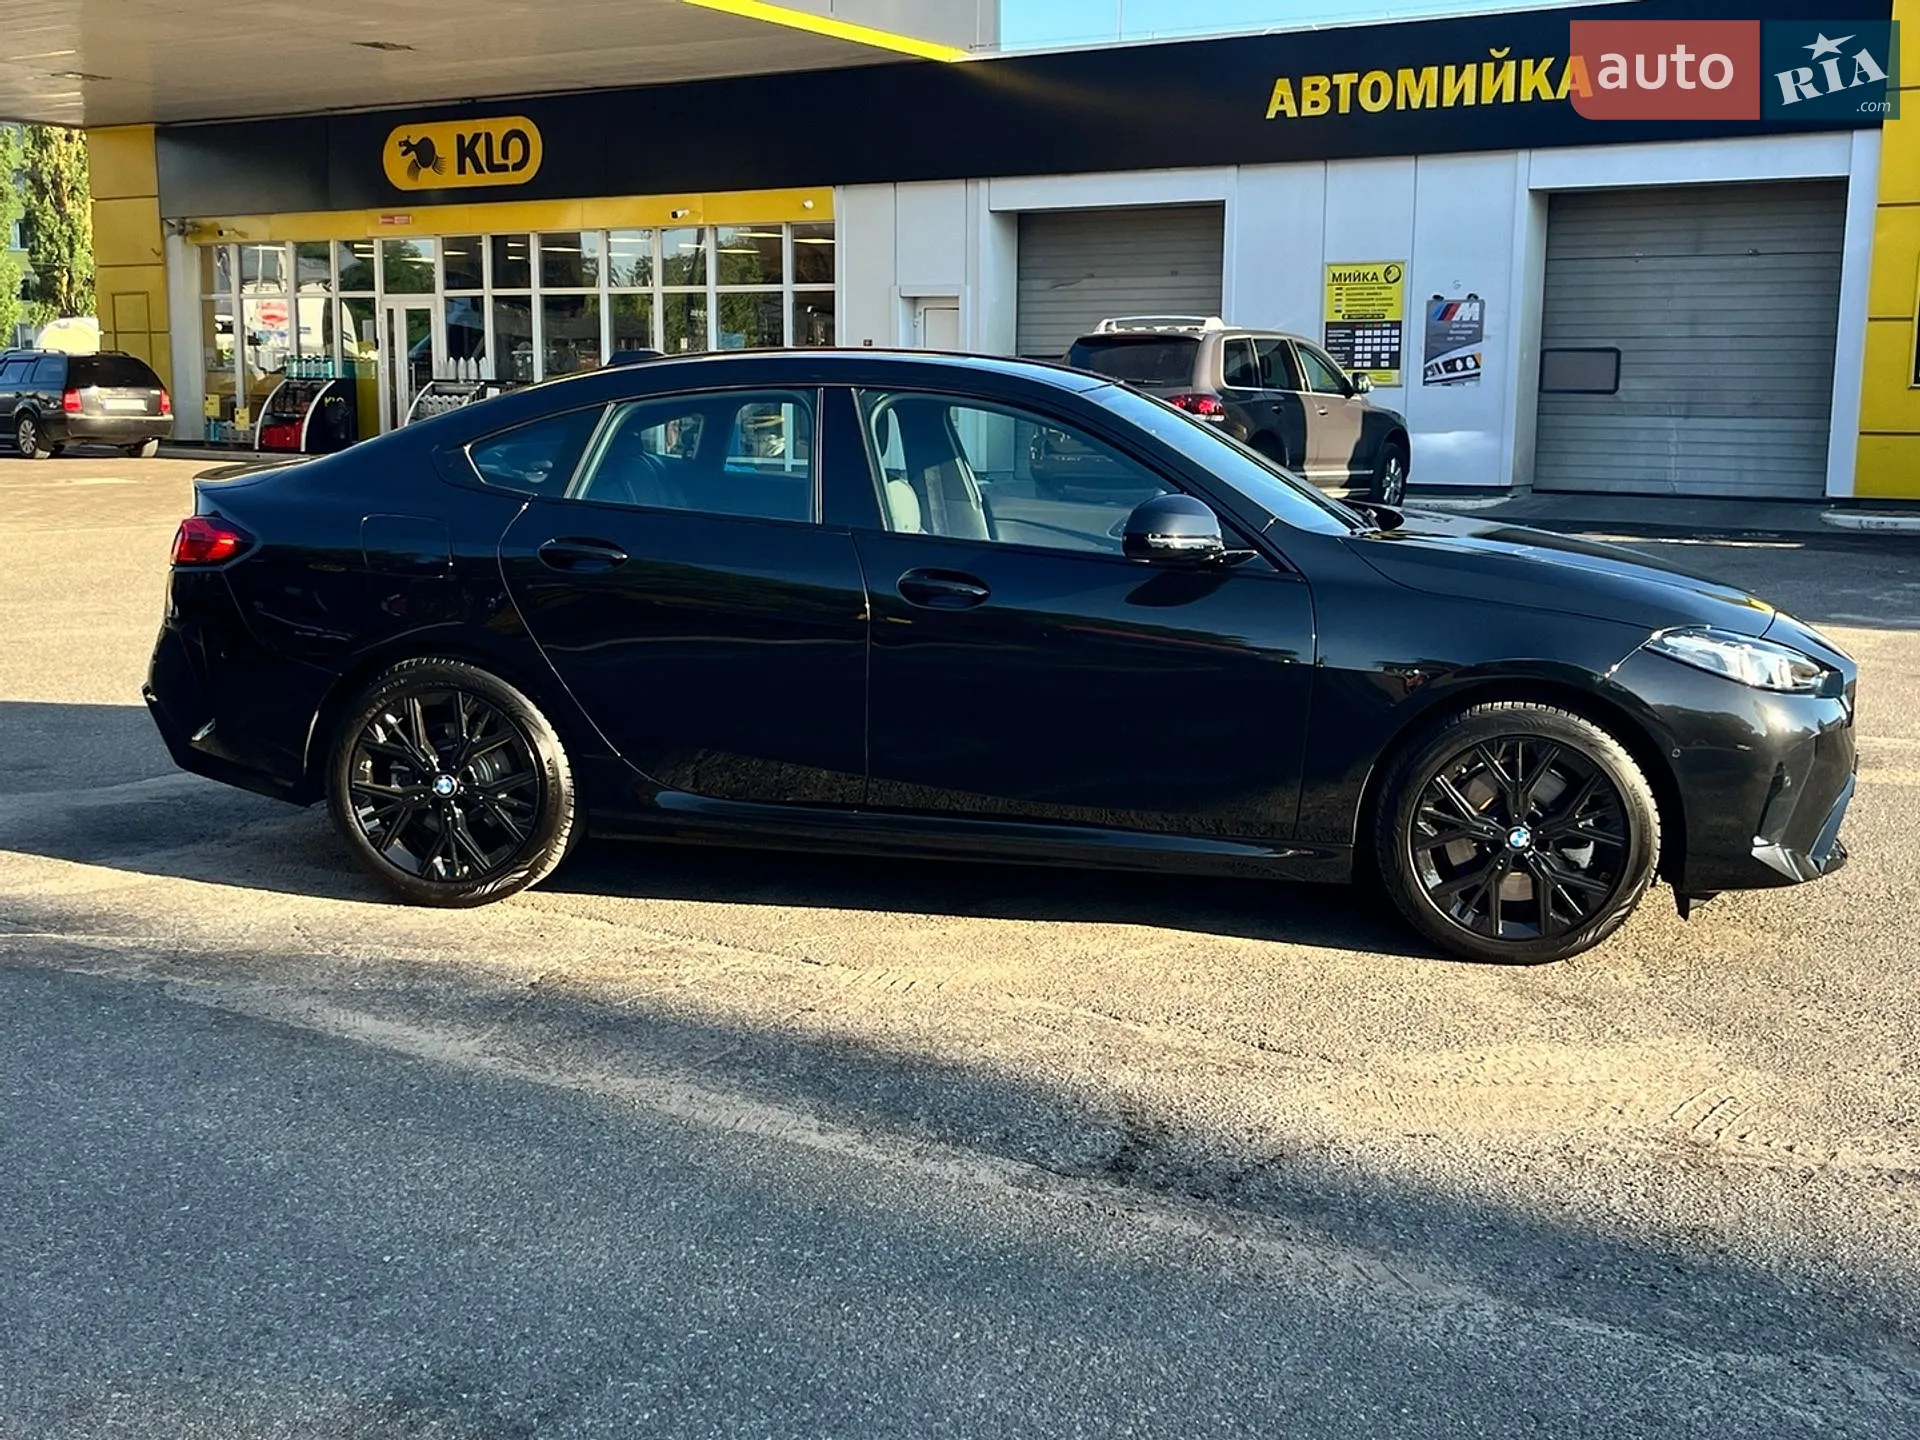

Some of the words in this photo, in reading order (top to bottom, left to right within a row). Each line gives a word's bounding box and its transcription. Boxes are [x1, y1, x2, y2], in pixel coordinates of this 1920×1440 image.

[1265, 47, 1594, 119] АВТОМИЙКА
[456, 128, 531, 175] KLO
[1331, 270, 1379, 283] МИЙКА
